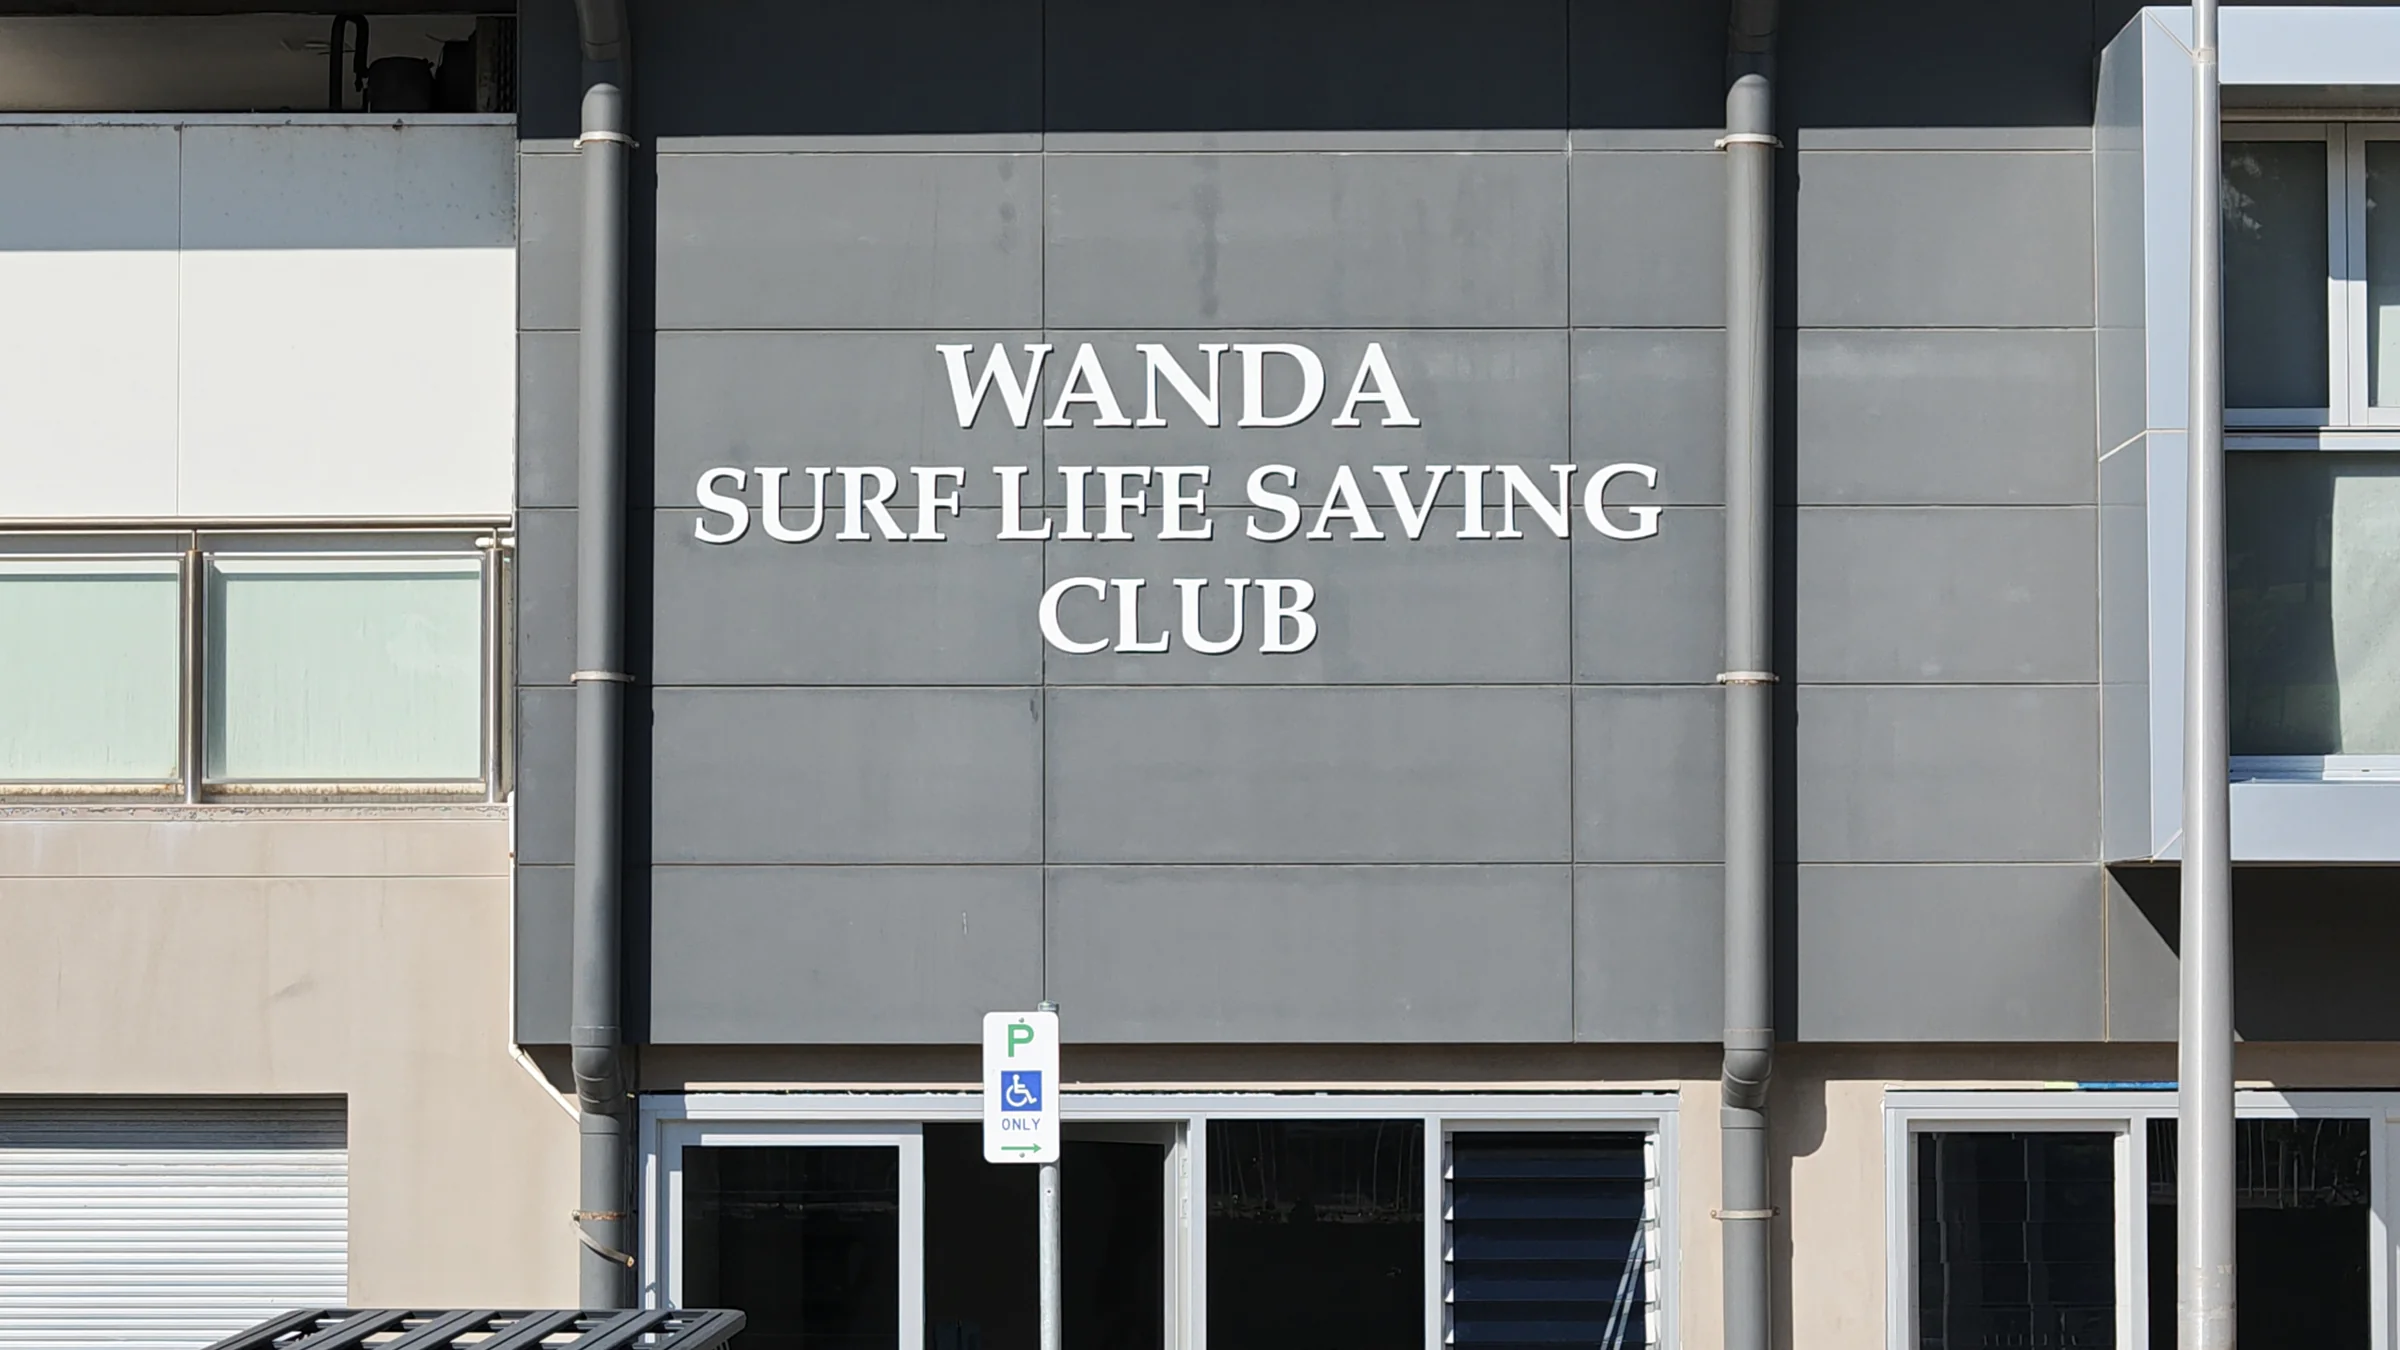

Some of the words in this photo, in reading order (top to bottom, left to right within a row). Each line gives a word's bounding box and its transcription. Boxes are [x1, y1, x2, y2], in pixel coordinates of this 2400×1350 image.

[935, 342, 1420, 427] WANDA
[694, 465, 965, 543] SURF
[992, 464, 1213, 540] LIFE
[1245, 462, 1663, 541] SAVING
[1038, 576, 1317, 653] CLUB
[1007, 1023, 1035, 1058] P
[1001, 1117, 1041, 1131] ONLY
